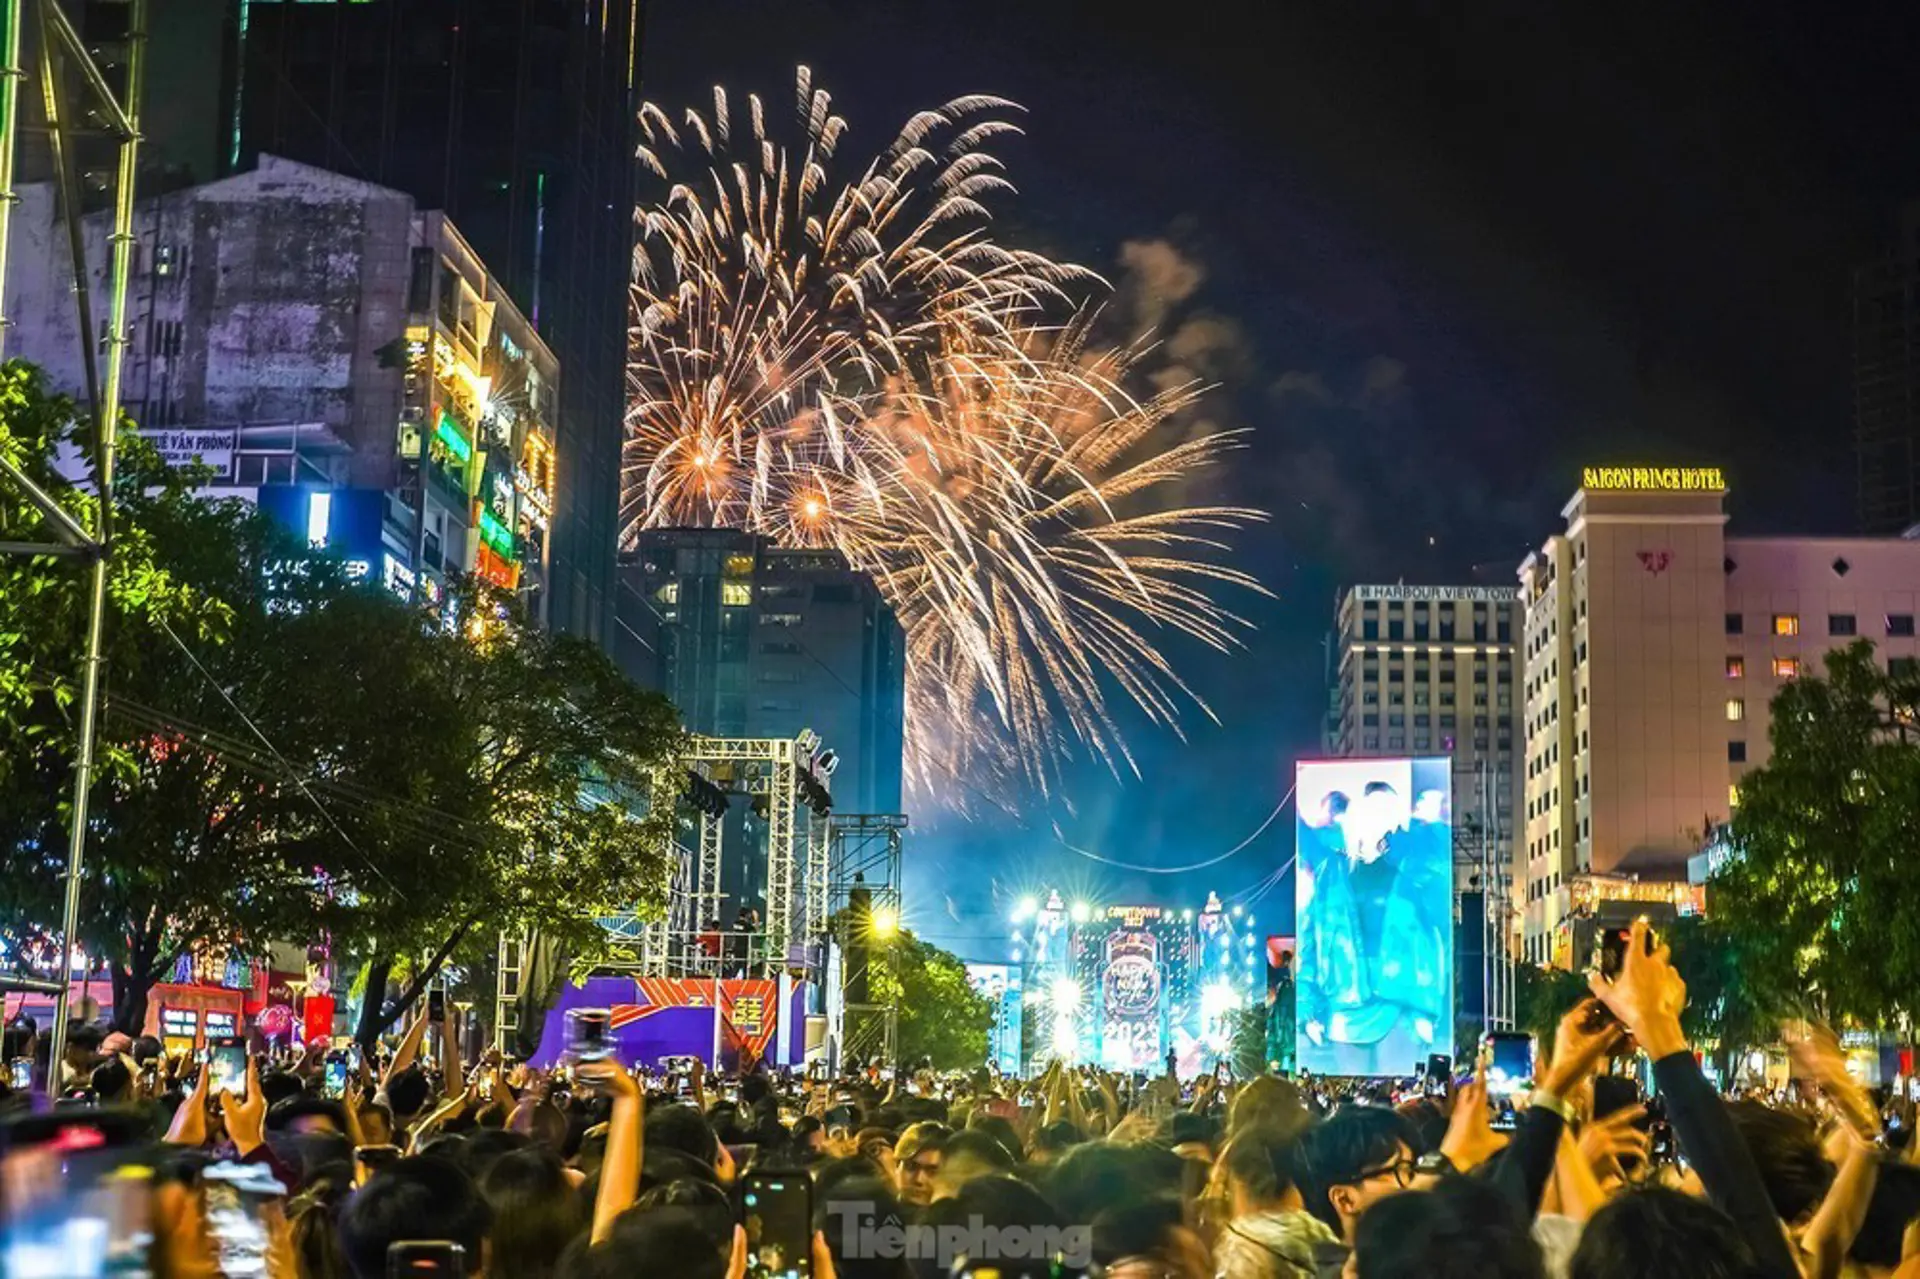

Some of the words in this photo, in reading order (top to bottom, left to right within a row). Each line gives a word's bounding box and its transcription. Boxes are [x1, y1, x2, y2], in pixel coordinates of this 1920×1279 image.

[1583, 467, 1632, 489] SAIGON
[1633, 467, 1680, 489] PRINCE
[1681, 467, 1725, 489] HOTEL
[1374, 586, 1441, 600] HARBOUR
[1443, 586, 1478, 600] VIEW
